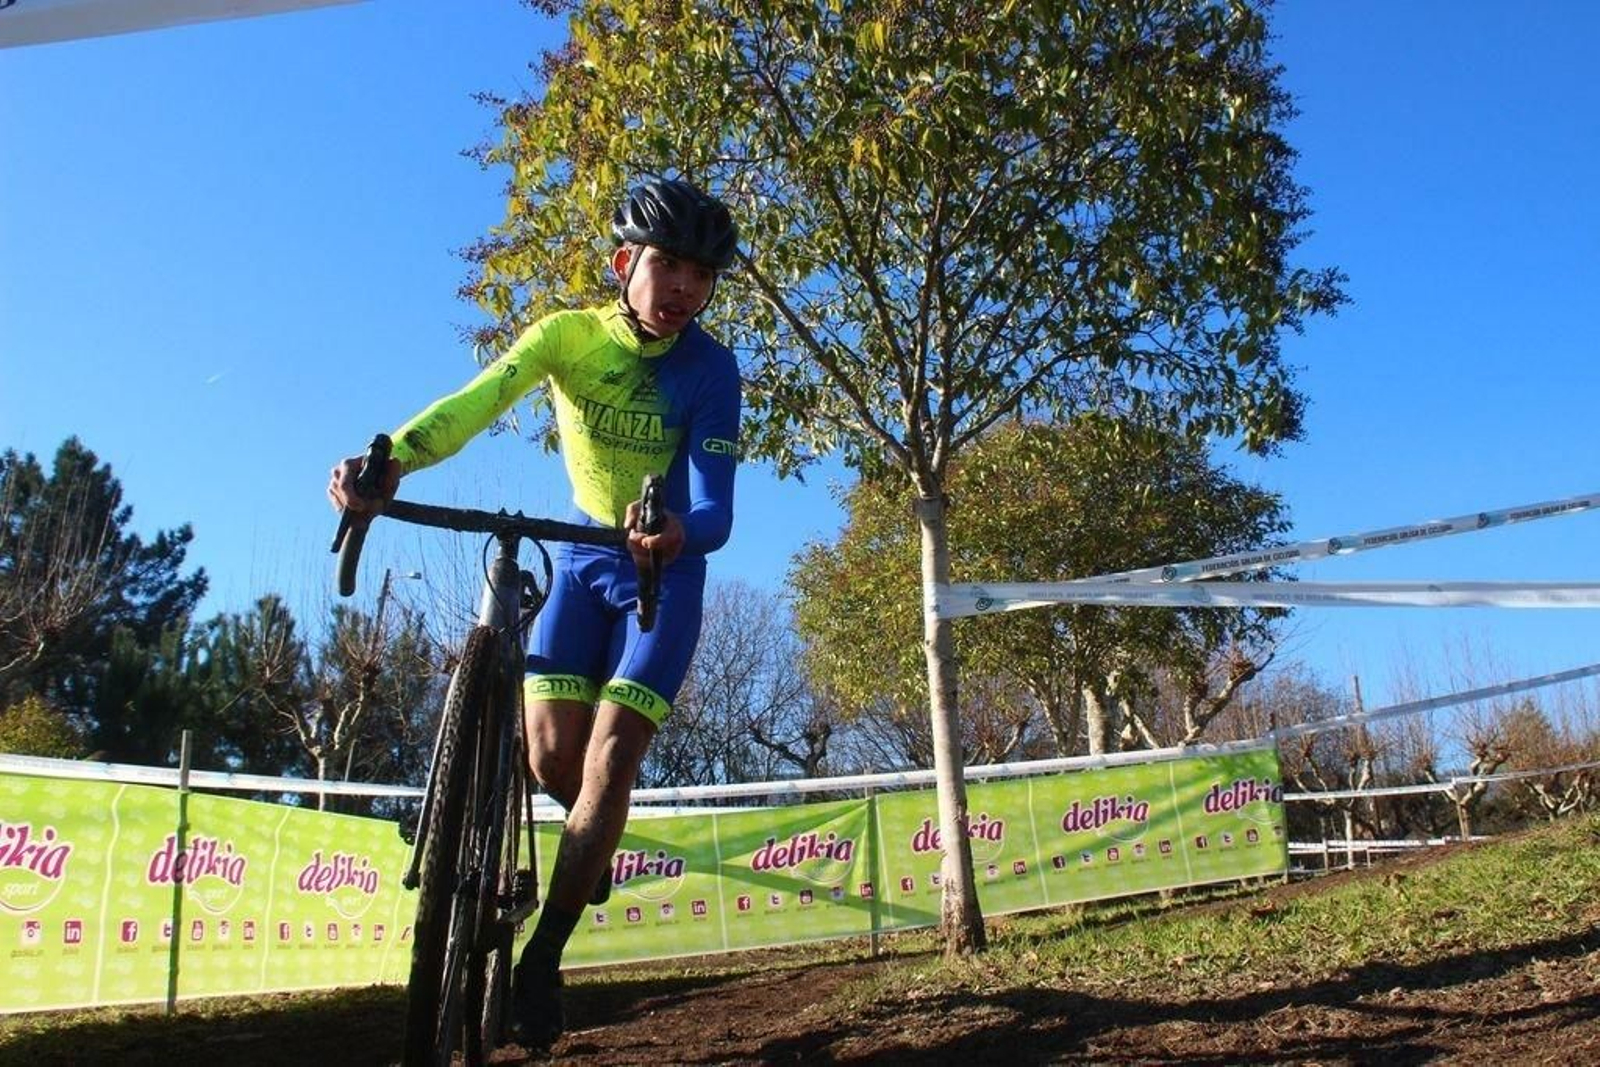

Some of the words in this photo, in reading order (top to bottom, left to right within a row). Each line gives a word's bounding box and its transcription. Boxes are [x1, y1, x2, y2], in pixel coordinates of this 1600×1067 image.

[1062, 796, 1149, 832] delikia
[1204, 779, 1283, 813] delikia
[0, 824, 70, 879] ikia
[751, 832, 853, 871] delikia
[913, 814, 1003, 852] dekia
[148, 836, 246, 886] delikia
[298, 852, 378, 894] delikia
[613, 850, 684, 885] likia
